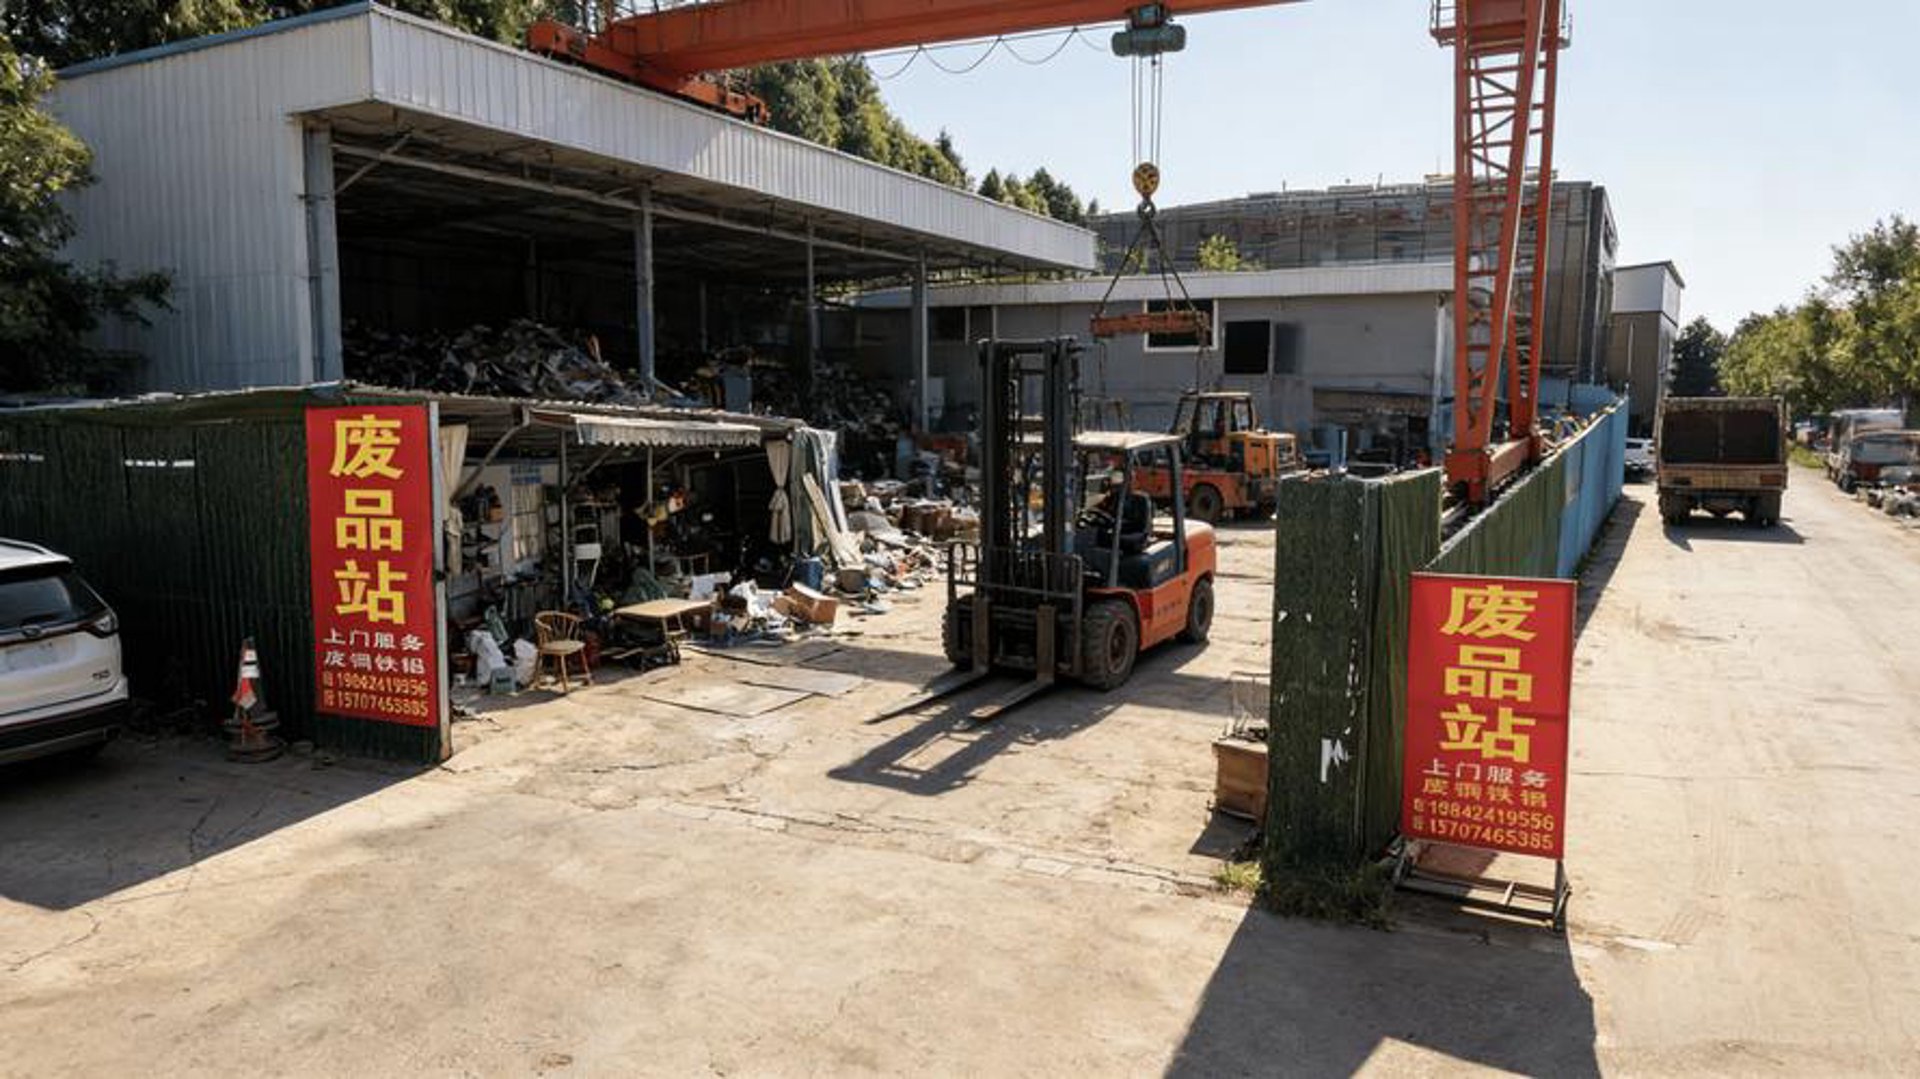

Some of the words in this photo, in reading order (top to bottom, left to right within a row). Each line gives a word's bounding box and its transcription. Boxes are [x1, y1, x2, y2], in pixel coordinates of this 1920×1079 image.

[329, 414, 407, 625] 废品站
[323, 627, 425, 651] 上门服务
[1440, 584, 1539, 763] 废品站
[1422, 757, 1552, 788] 上门服务
[1430, 818, 1554, 850] 15707465385
